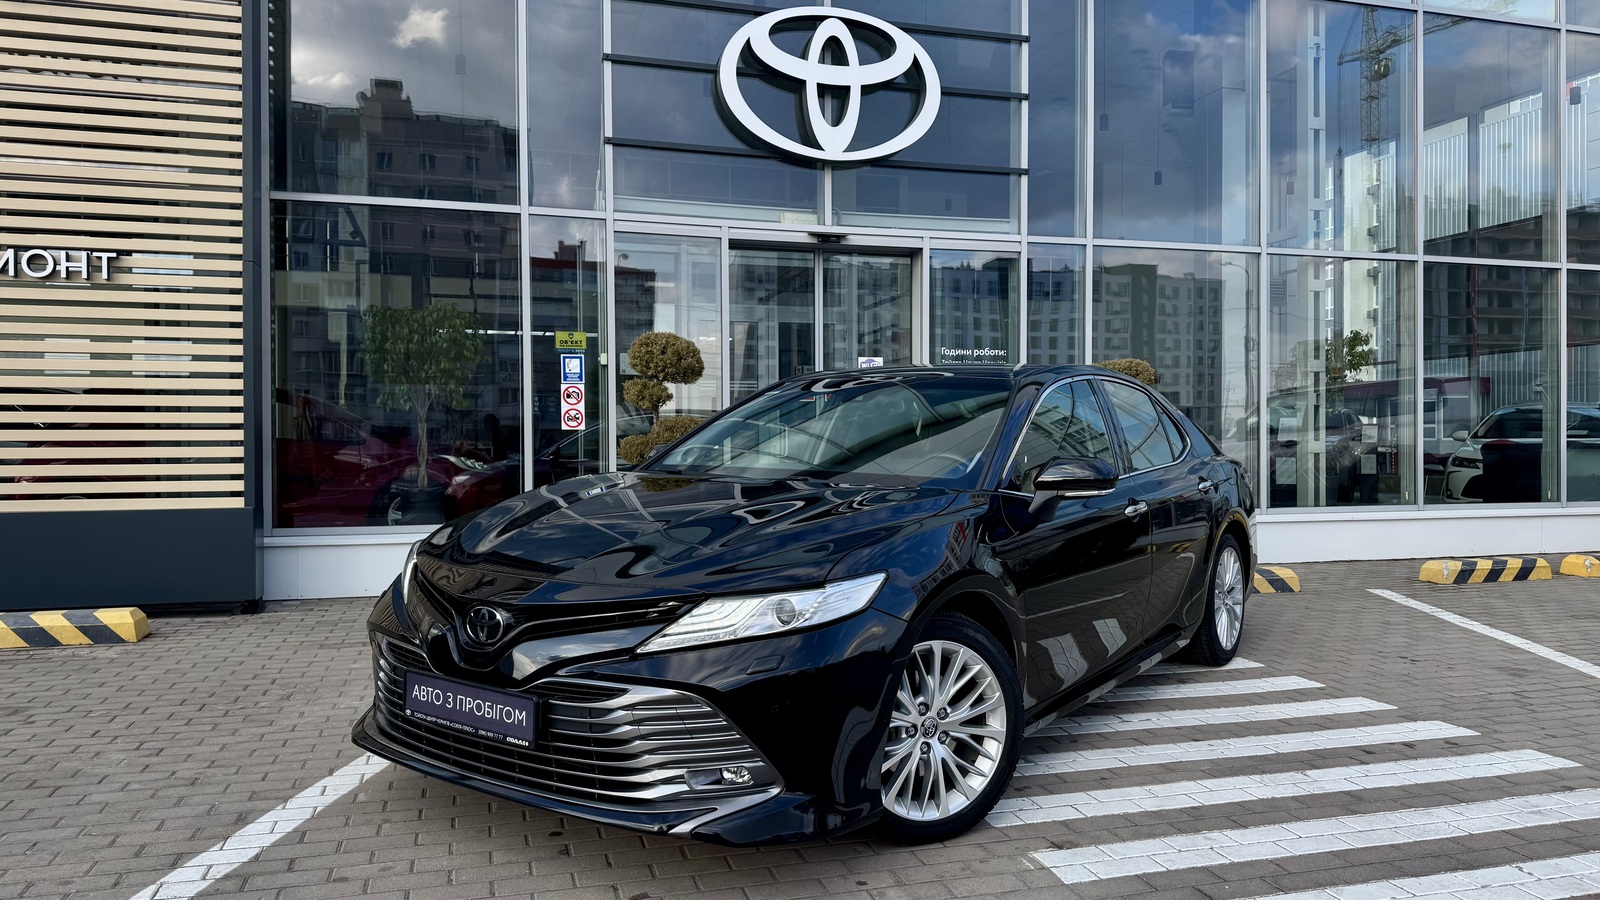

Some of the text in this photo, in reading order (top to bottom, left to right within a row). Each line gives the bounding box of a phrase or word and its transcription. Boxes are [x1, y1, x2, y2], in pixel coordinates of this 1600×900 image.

[941, 347, 1007, 357] Години роботи:
[412, 684, 443, 705] АВТО
[456, 694, 526, 726] ПРОБІГОМ
